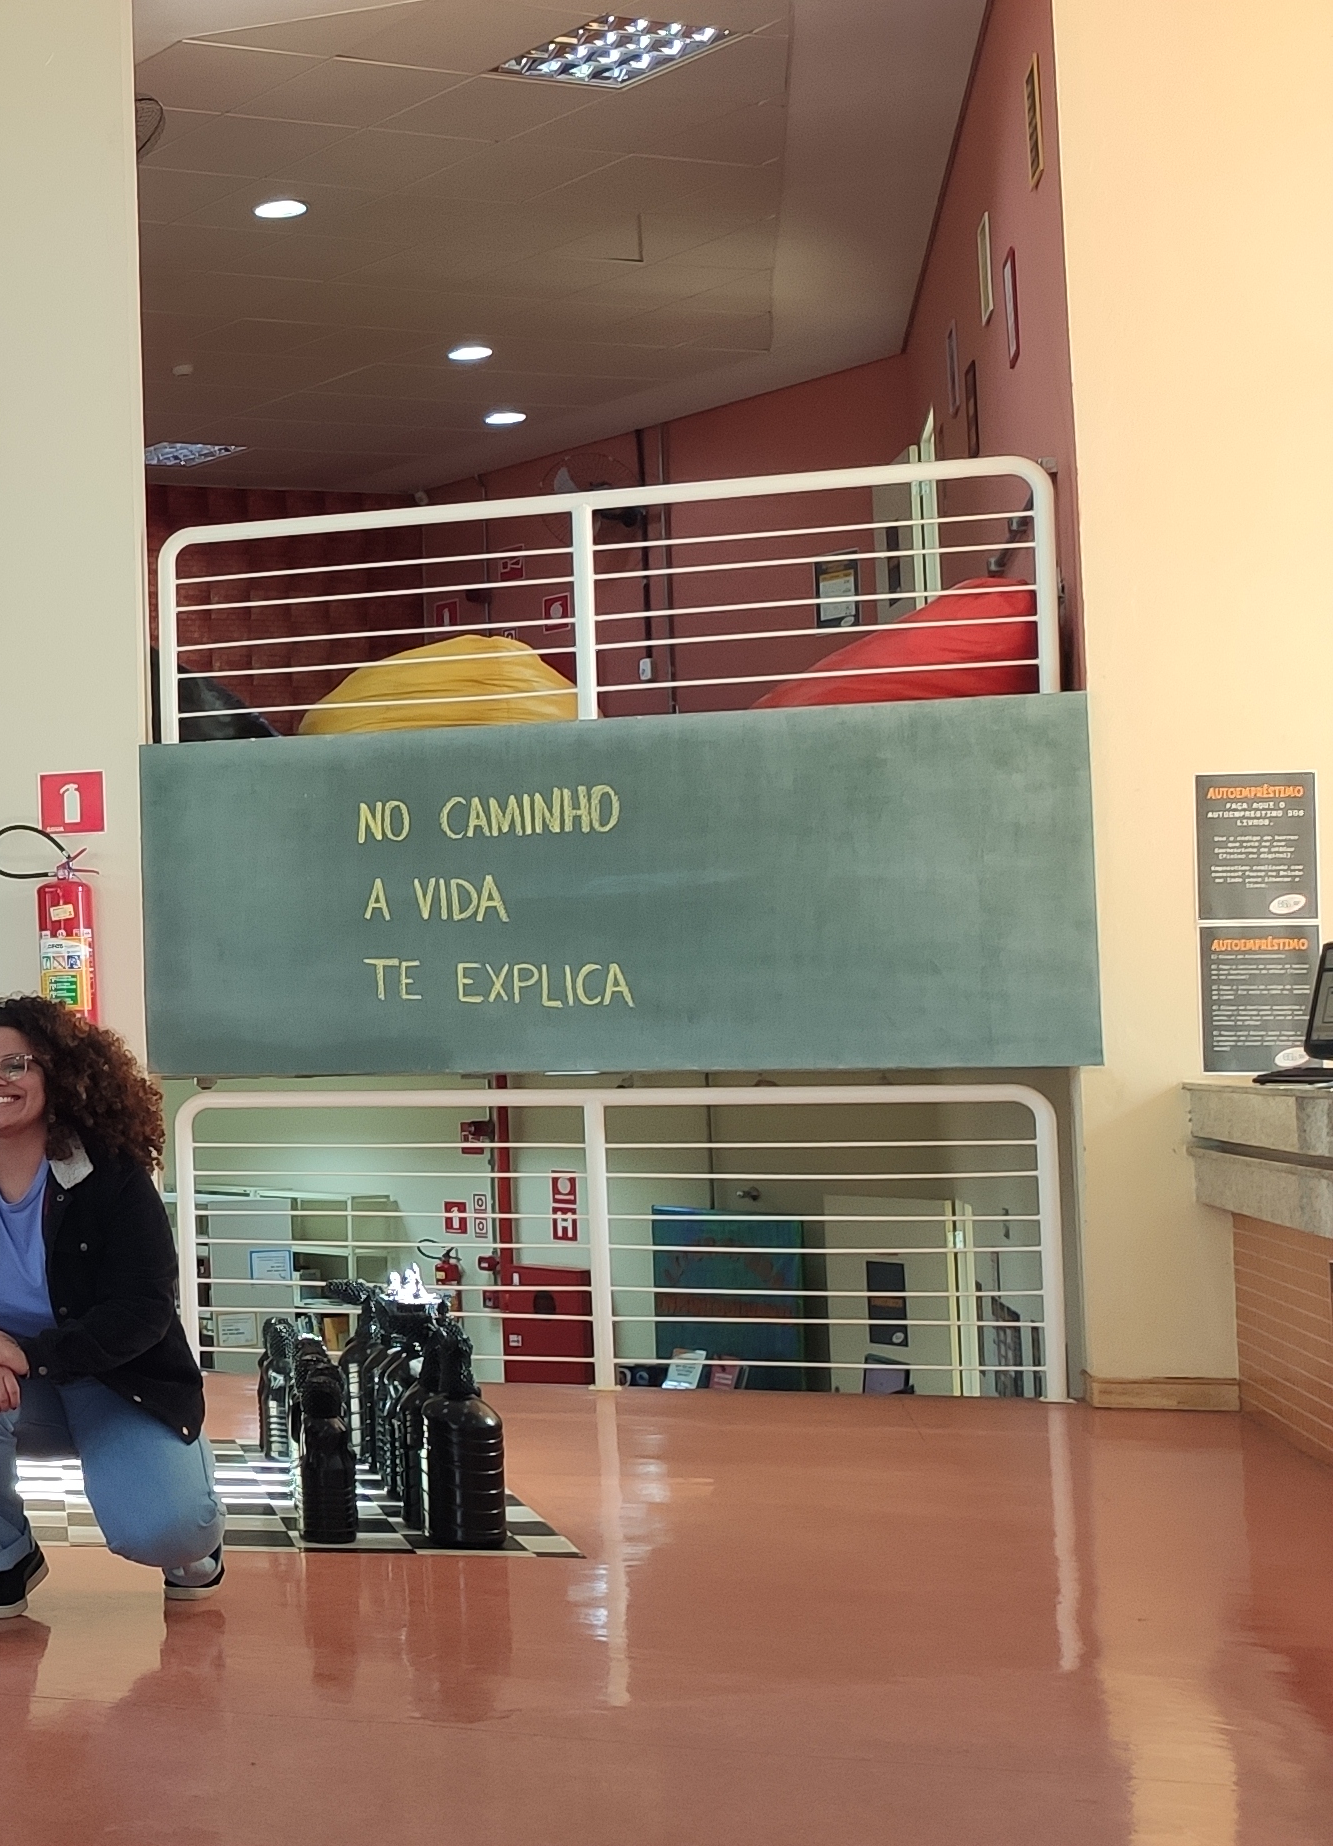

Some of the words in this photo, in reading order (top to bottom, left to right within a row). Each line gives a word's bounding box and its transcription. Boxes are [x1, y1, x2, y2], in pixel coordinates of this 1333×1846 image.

[358, 800, 410, 844] NO
[440, 784, 620, 839] CAMINHO
[1207, 784, 1304, 799] AUTOEMPRÉSTIMO
[364, 878, 391, 921] A
[413, 874, 510, 923] VIDA
[362, 958, 423, 1001] TE
[456, 963, 636, 1008] EXPLICA
